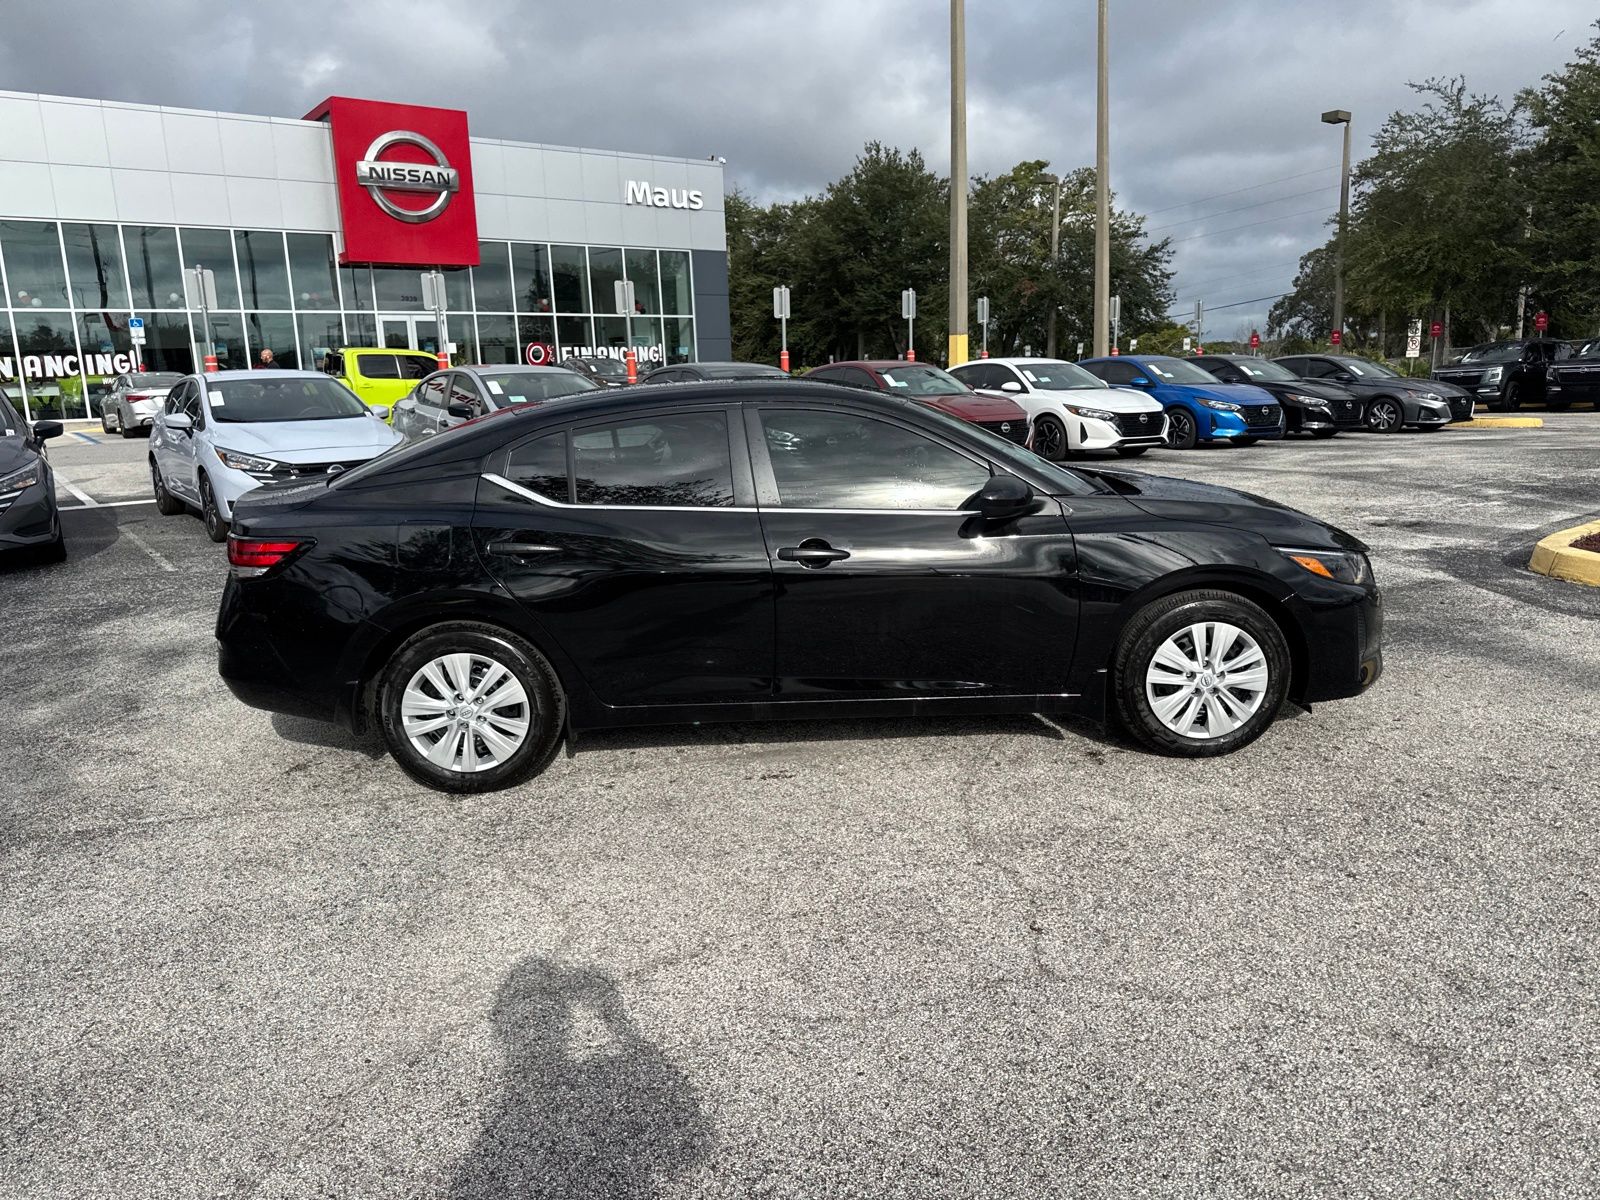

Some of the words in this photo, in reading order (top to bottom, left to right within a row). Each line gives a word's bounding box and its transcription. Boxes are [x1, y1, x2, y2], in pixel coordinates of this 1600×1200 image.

[368, 166, 451, 186] NISSAN
[626, 179, 704, 210] Maus
[561, 343, 663, 362] FINANCING!
